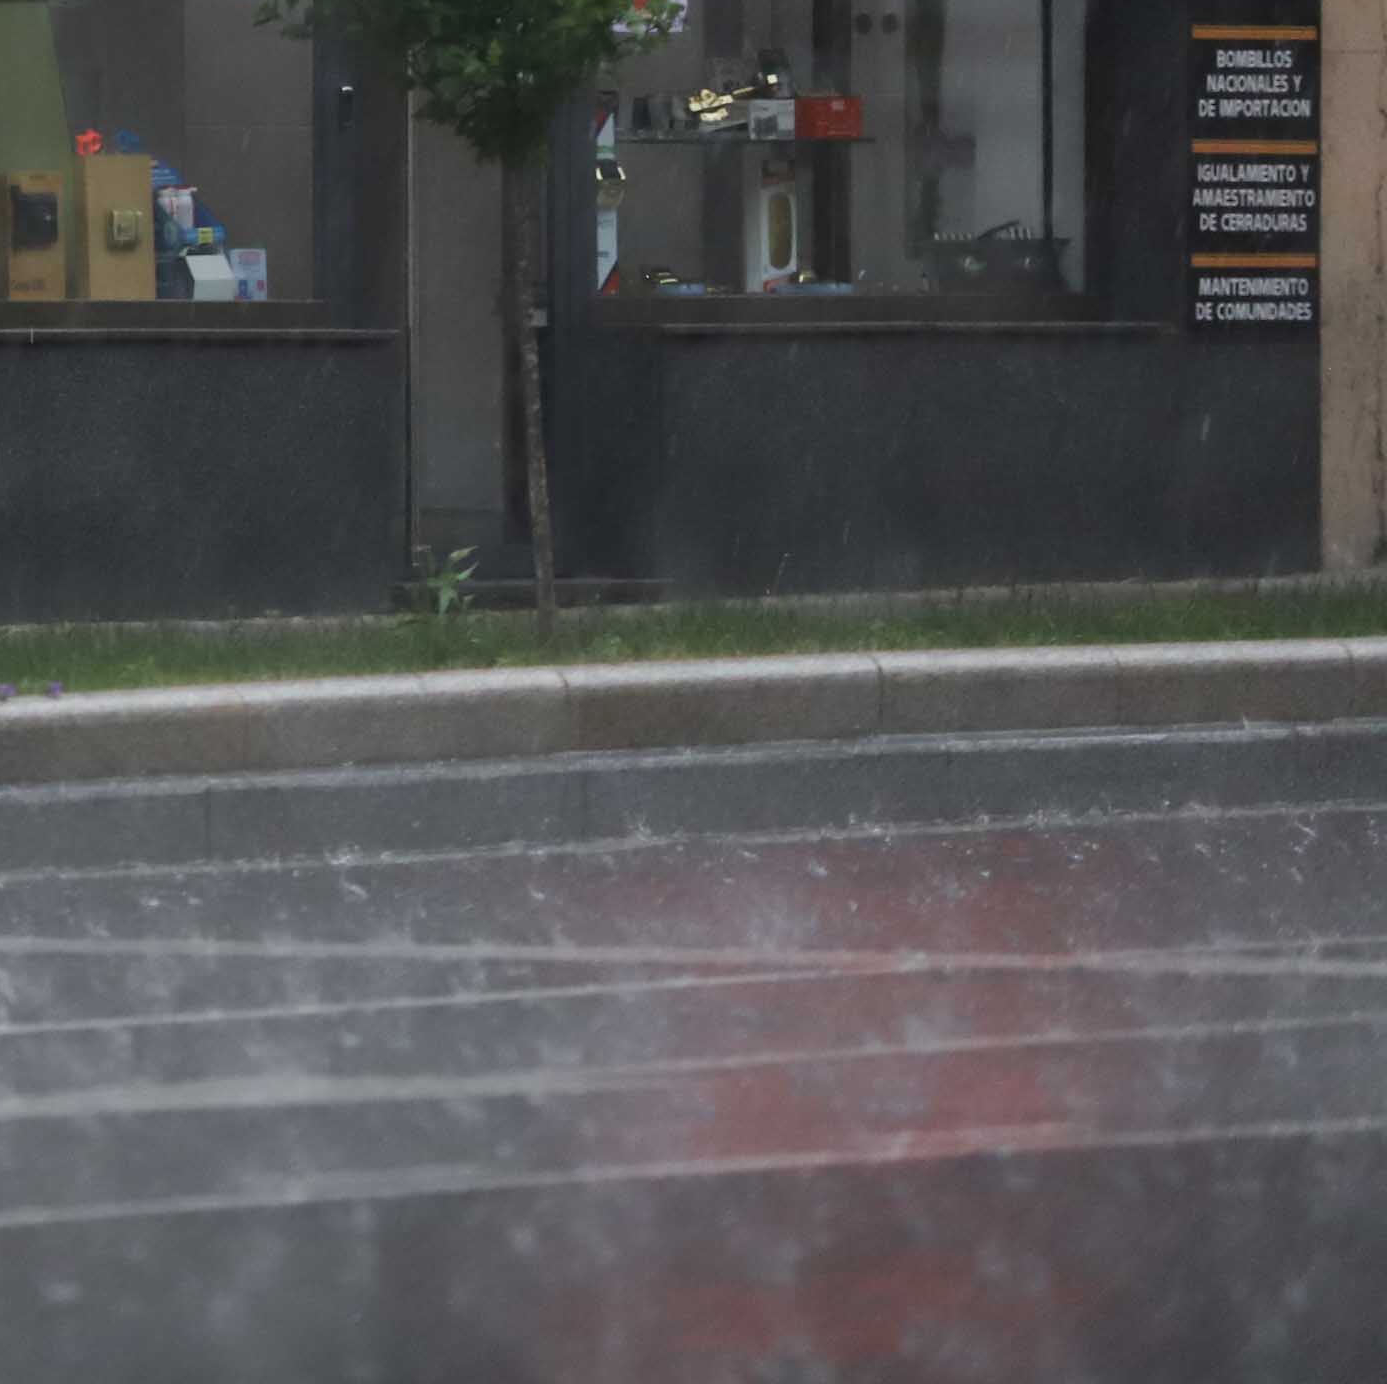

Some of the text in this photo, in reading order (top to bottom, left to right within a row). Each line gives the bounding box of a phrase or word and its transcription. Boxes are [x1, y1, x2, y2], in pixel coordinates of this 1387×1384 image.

[1216, 49, 1292, 68] BOMBILLOS
[1206, 75, 1303, 93] NACIONALES Y
[1198, 99, 1311, 118] DE IMPORTACION
[1197, 165, 1310, 183] IGUALAMIENTO Y
[1192, 189, 1315, 207] AMAESTRAMIENTO
[1199, 213, 1307, 232] DE CERRADURAS
[1198, 277, 1309, 296] MANTENIMIENTO
[1195, 302, 1312, 321] DE COMUNIDADES
